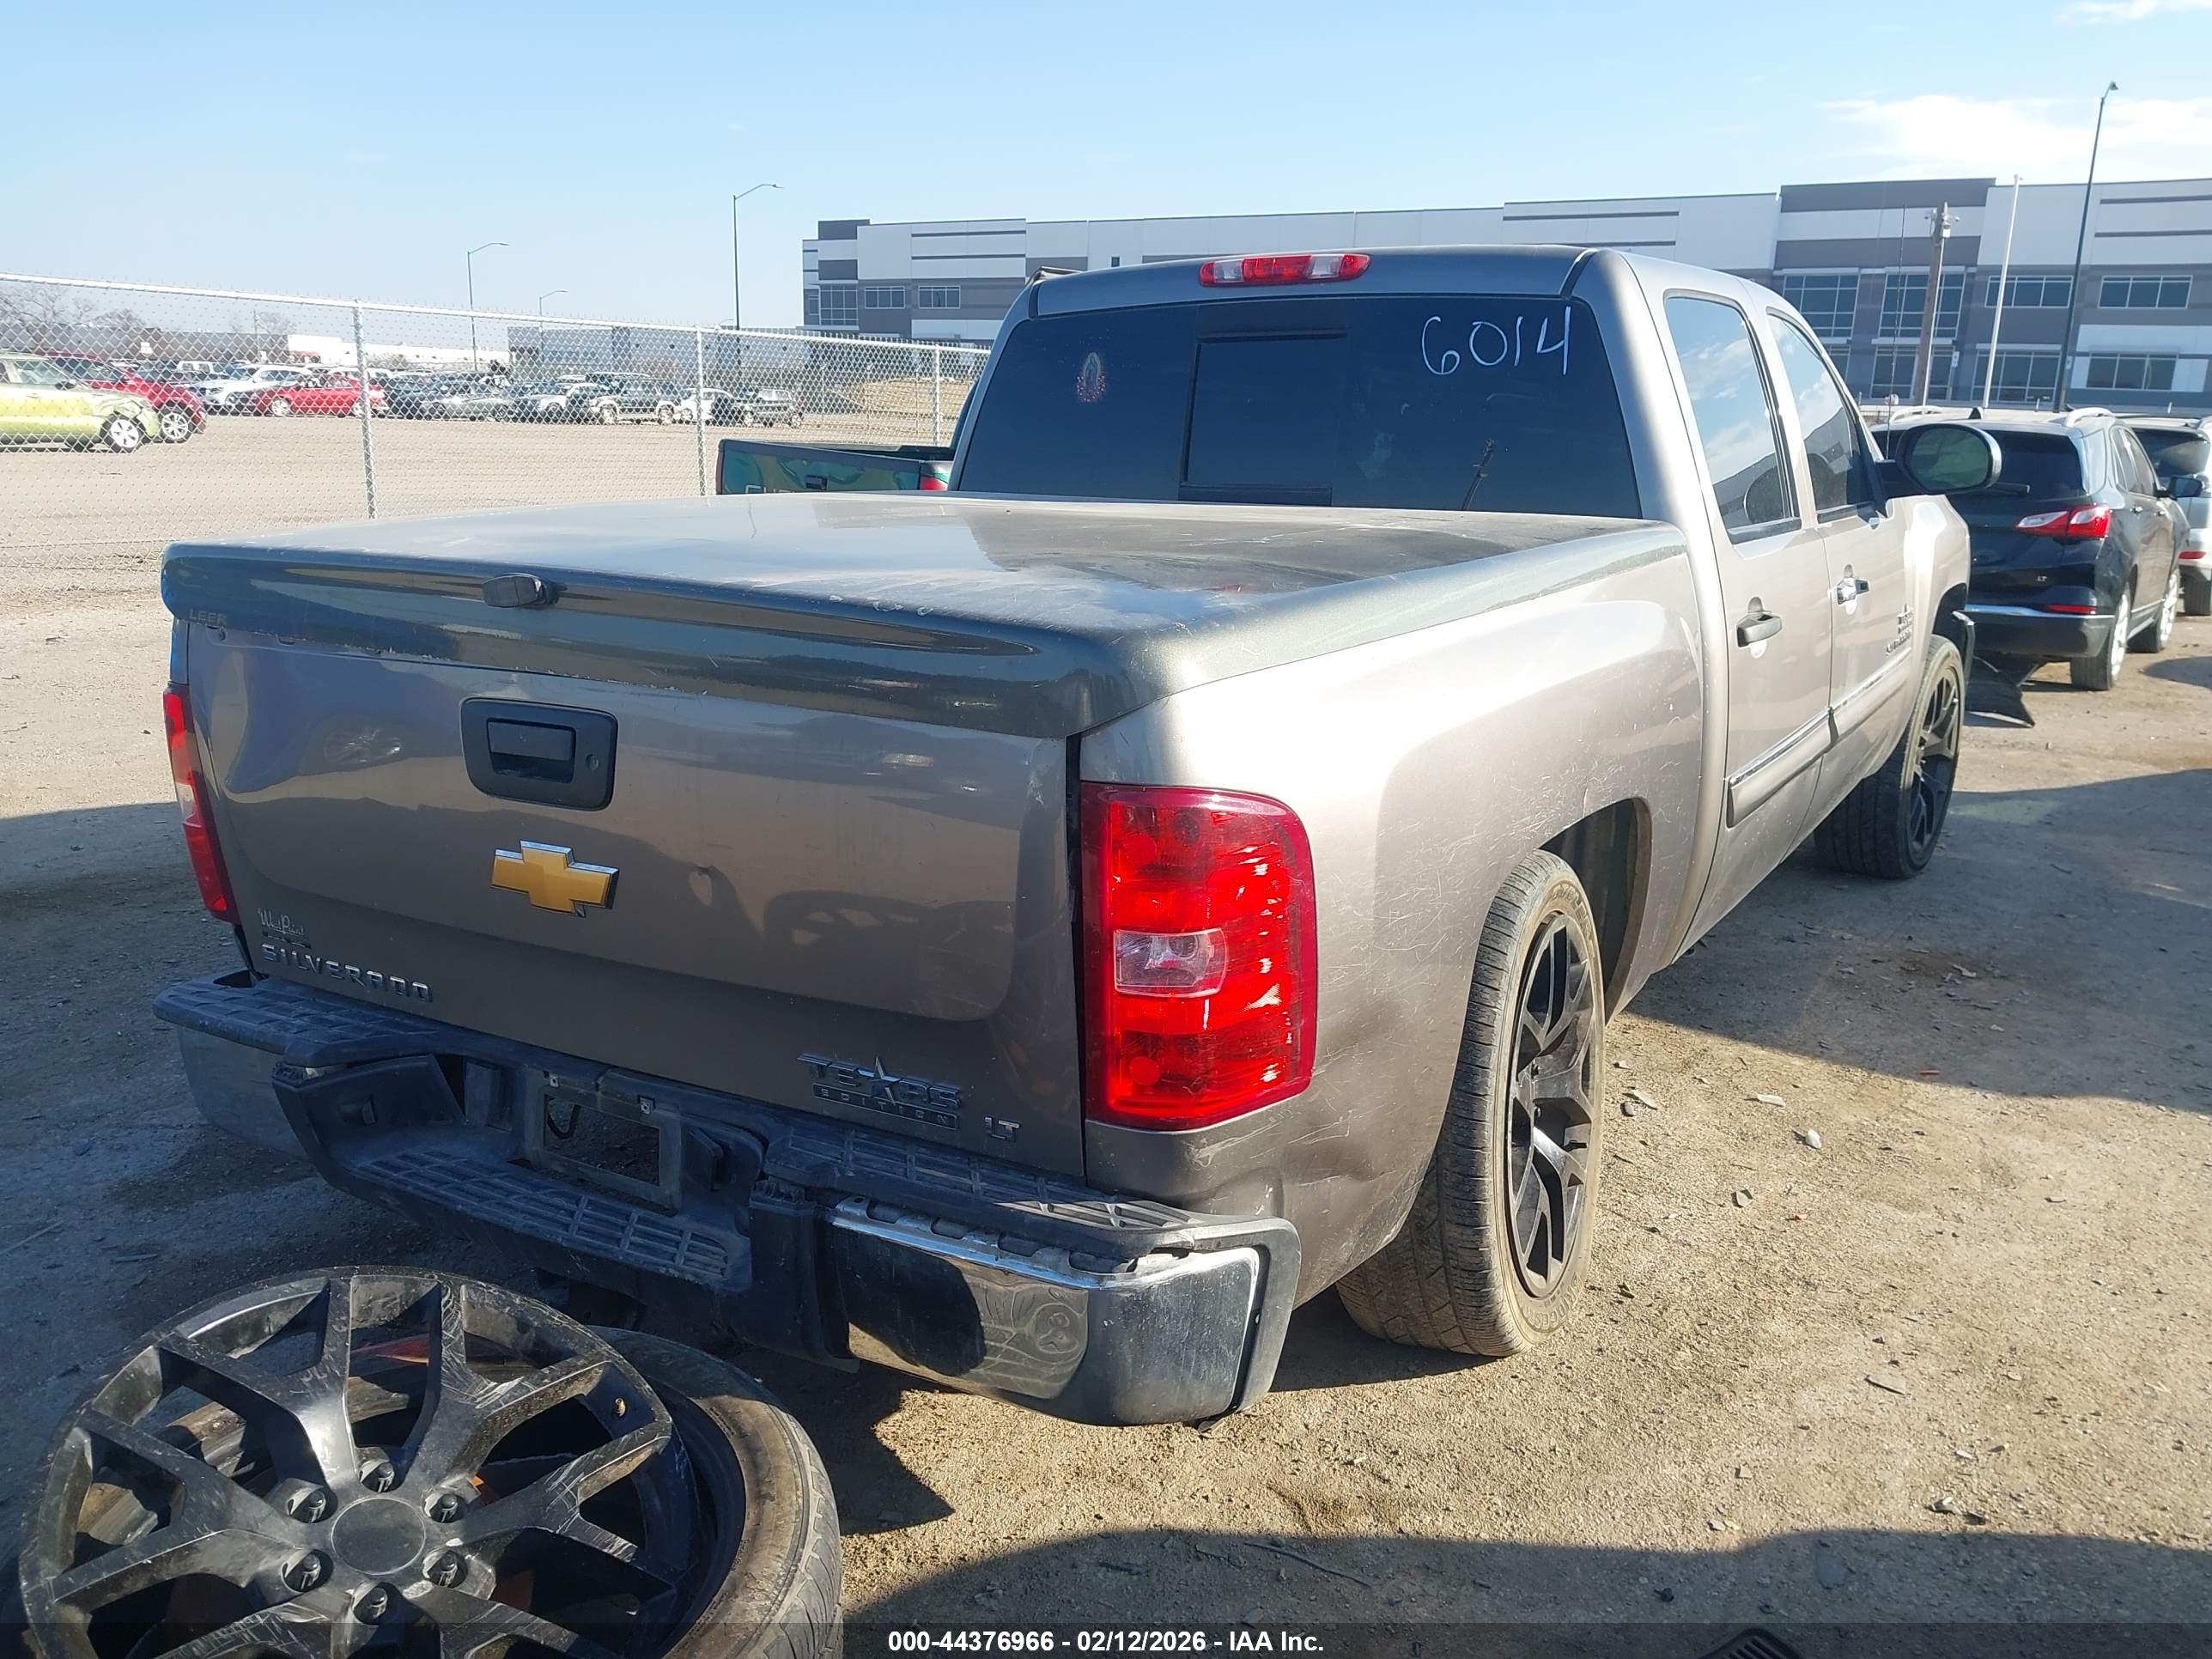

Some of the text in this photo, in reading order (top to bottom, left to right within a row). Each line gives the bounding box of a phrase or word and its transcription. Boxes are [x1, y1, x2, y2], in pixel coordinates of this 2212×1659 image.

[1421, 305, 1571, 375] 6014
[261, 943, 433, 1003] SILVERADO
[819, 1087, 951, 1127] EDITION
[984, 1116, 1021, 1141] LT
